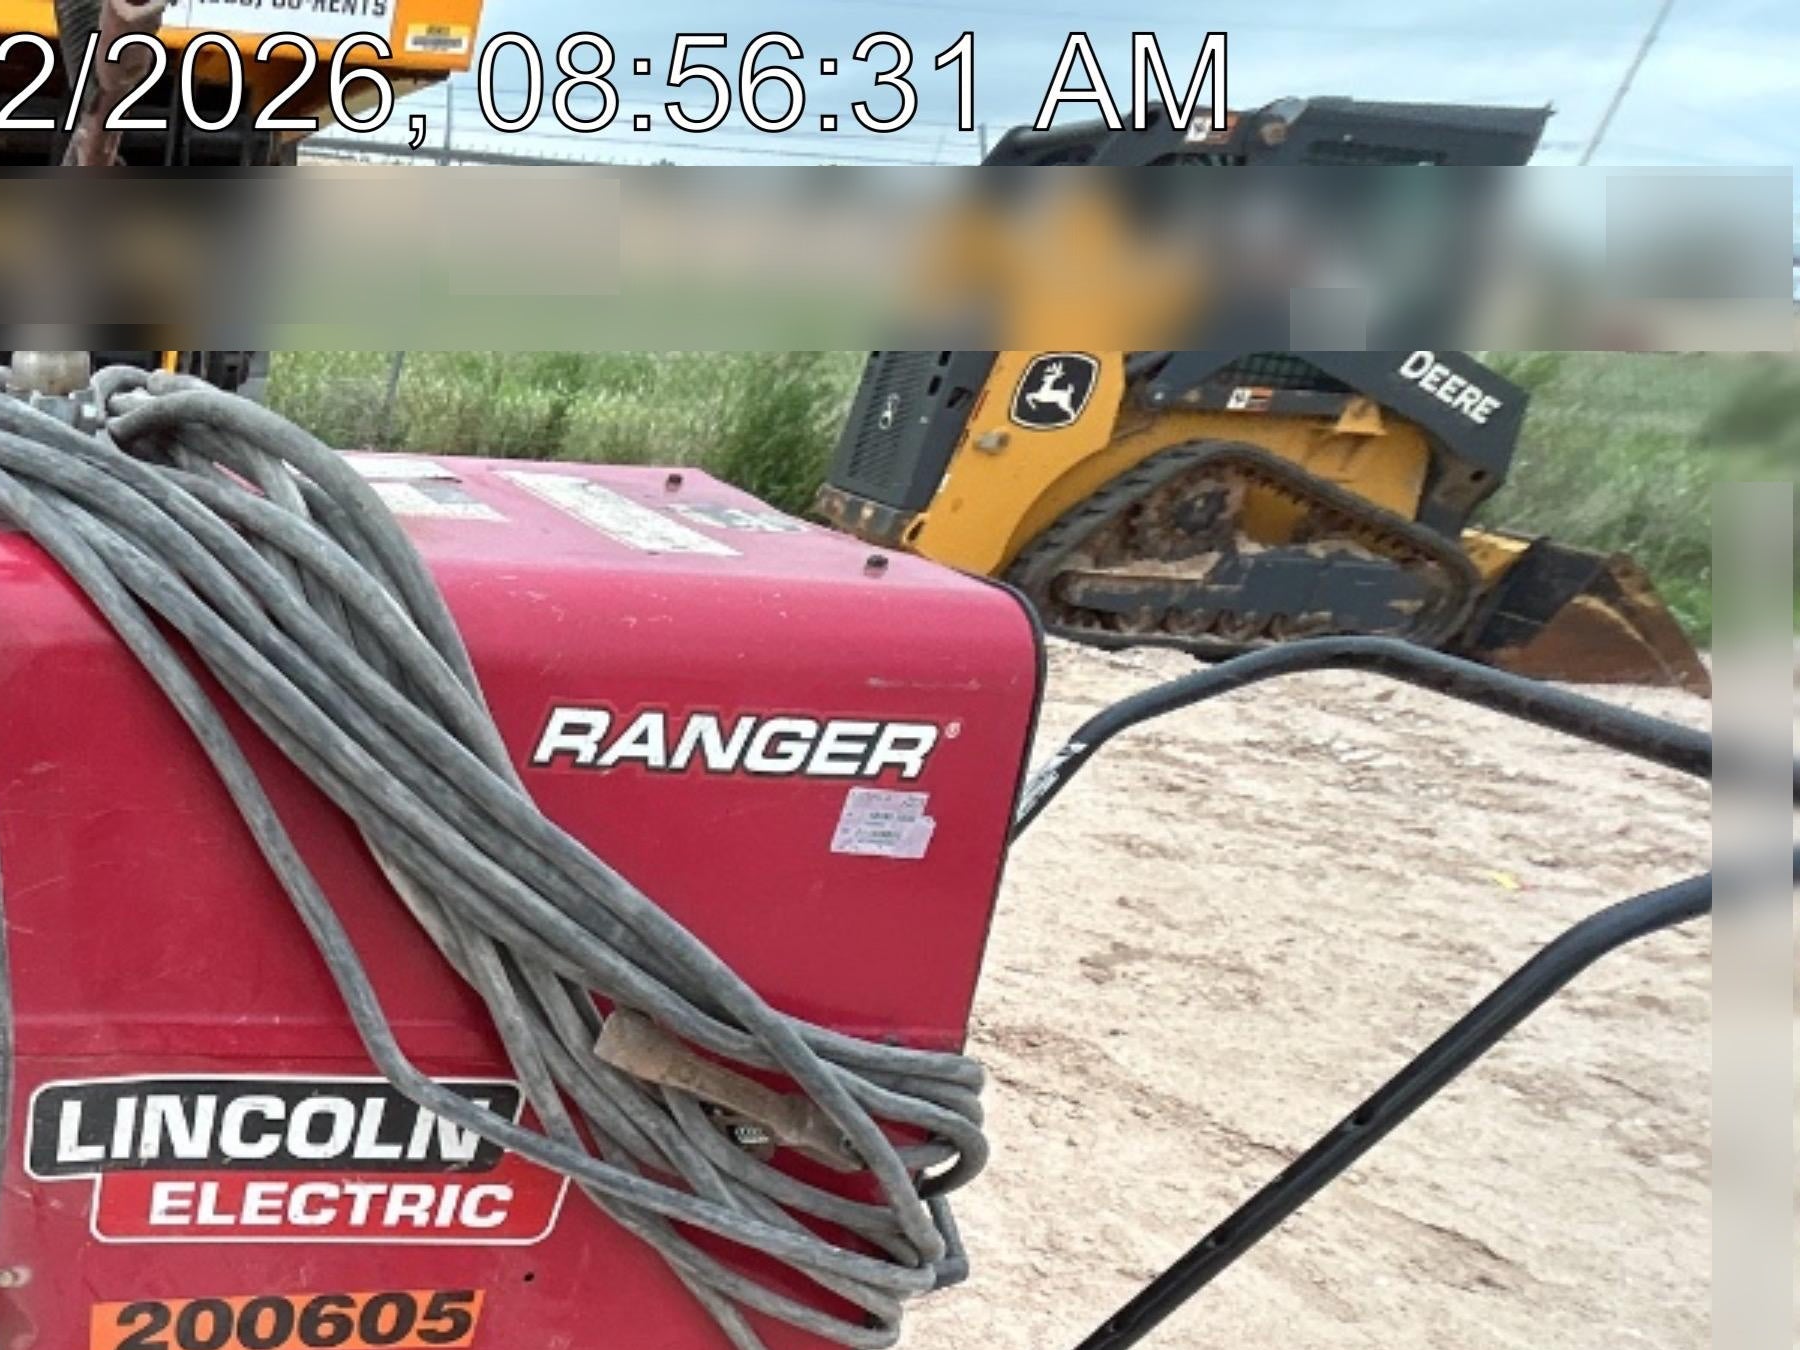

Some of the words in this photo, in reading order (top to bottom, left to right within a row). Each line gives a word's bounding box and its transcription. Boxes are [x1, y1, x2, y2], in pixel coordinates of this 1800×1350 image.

[1399, 350, 1503, 424] DEERE
[55, 1094, 493, 1163] LINCOLN
[148, 1181, 514, 1229] ELECTRIC
